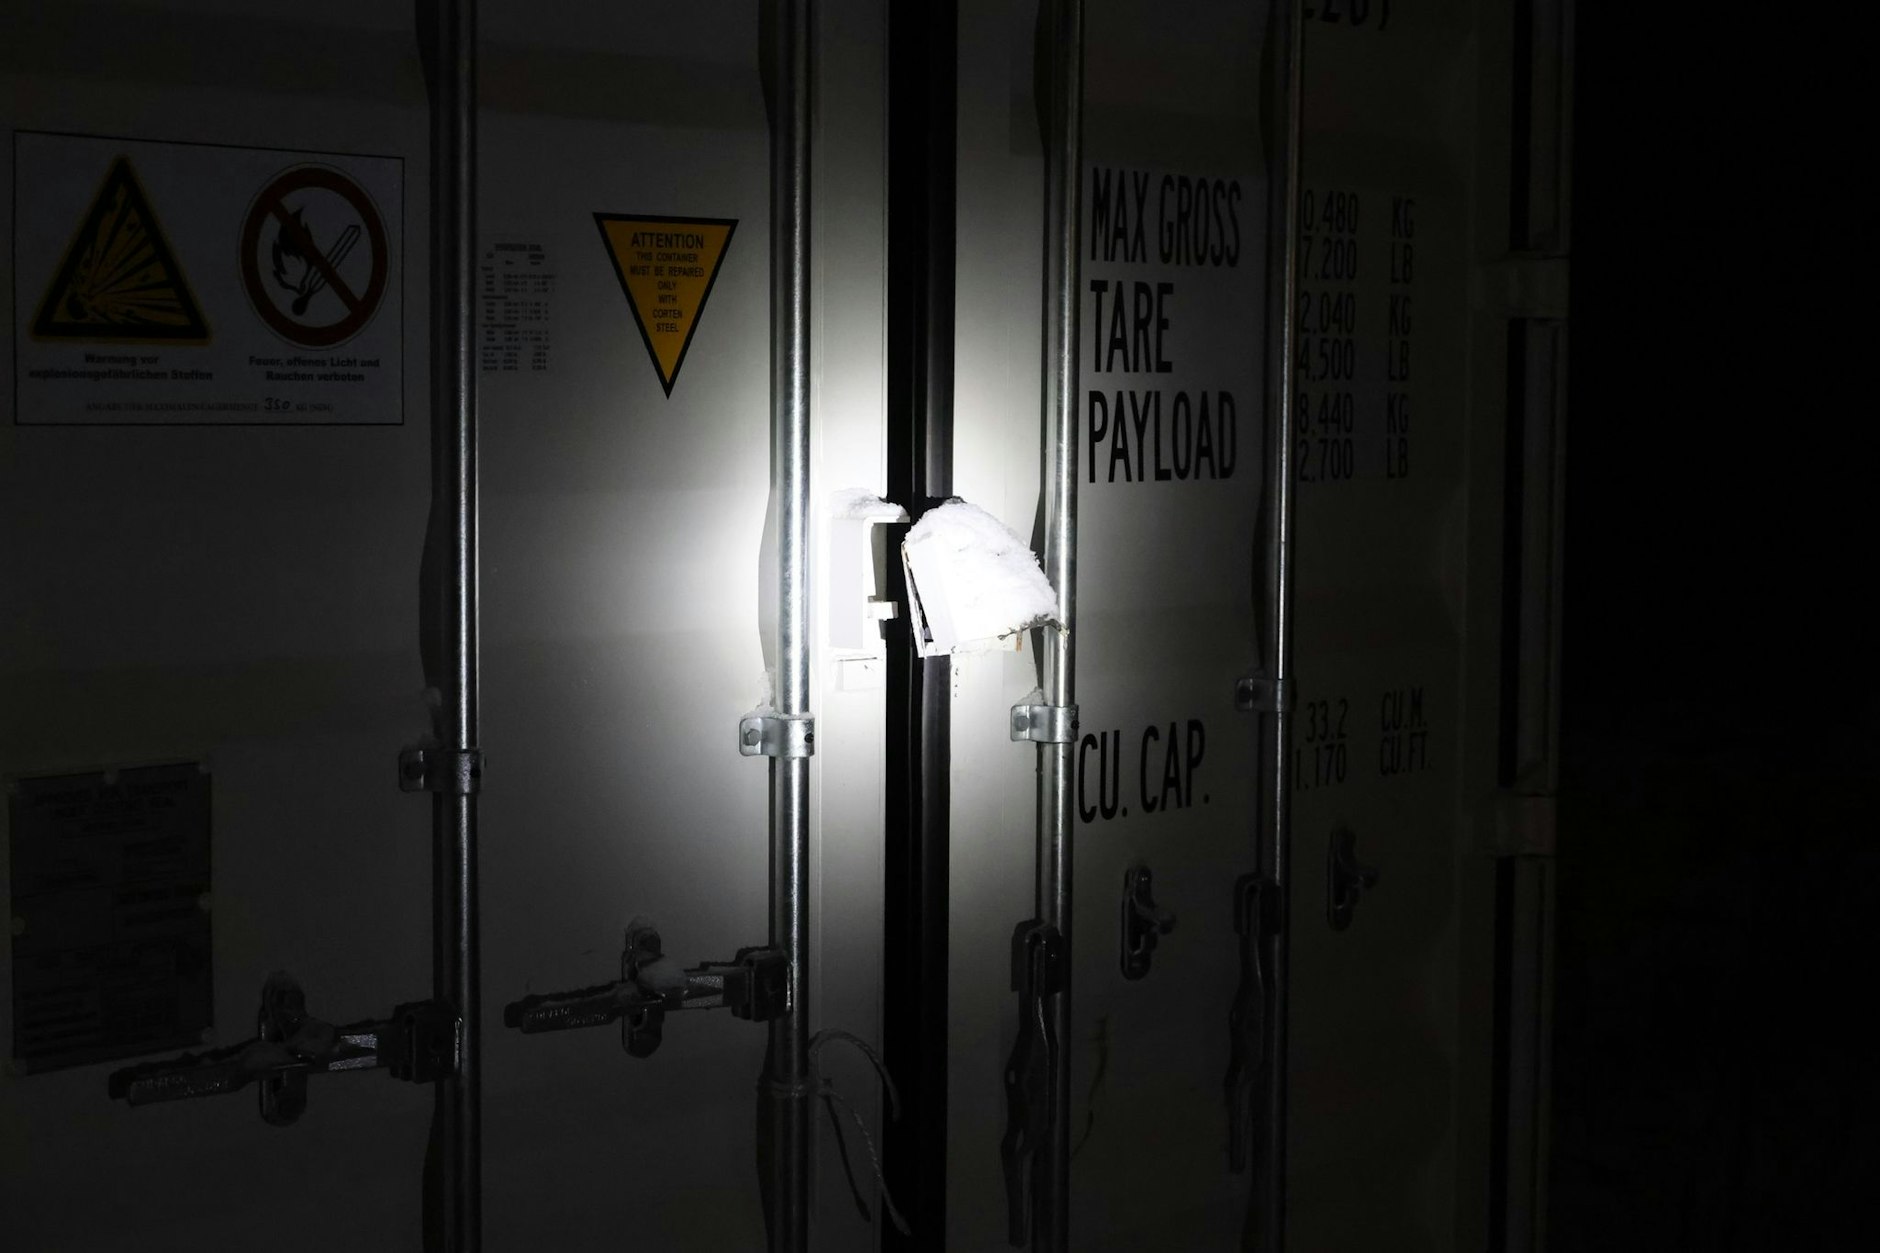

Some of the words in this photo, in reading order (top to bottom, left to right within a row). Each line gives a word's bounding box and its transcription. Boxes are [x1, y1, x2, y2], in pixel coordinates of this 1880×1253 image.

[1091, 167, 1149, 262] MAX
[1159, 174, 1242, 268] GROSS
[1392, 195, 1415, 239] KG
[631, 231, 705, 249] ATTENTION
[630, 265, 650, 277] MUST
[654, 266, 665, 277] BE
[668, 266, 705, 278] REPAIRED
[636, 251, 653, 261] THIS
[656, 252, 698, 263] CONTAINER
[1390, 241, 1413, 285] LB
[657, 280, 677, 291] ONLY
[658, 294, 677, 305] WITH
[652, 308, 683, 319] CORTEN
[656, 322, 679, 333] STEEL
[1090, 279, 1174, 373] TARE
[1389, 293, 1412, 336] KG
[85, 354, 137, 367] Warnung
[140, 355, 159, 365] vor
[171, 369, 213, 381] Stoffen
[248, 355, 283, 368] Feuer,
[286, 356, 327, 368] offenes
[330, 356, 357, 368] Licht
[360, 358, 380, 368] und
[1388, 339, 1410, 381] LB
[265, 370, 314, 382] Rauchen
[316, 371, 365, 382] verboten
[1387, 391, 1409, 435] KG
[1089, 390, 1237, 483] PAYLOAD
[1387, 437, 1409, 480] LB
[1306, 698, 1348, 742] 33.2
[1078, 729, 1128, 824] CU.
[1140, 718, 1210, 814] CAP.
